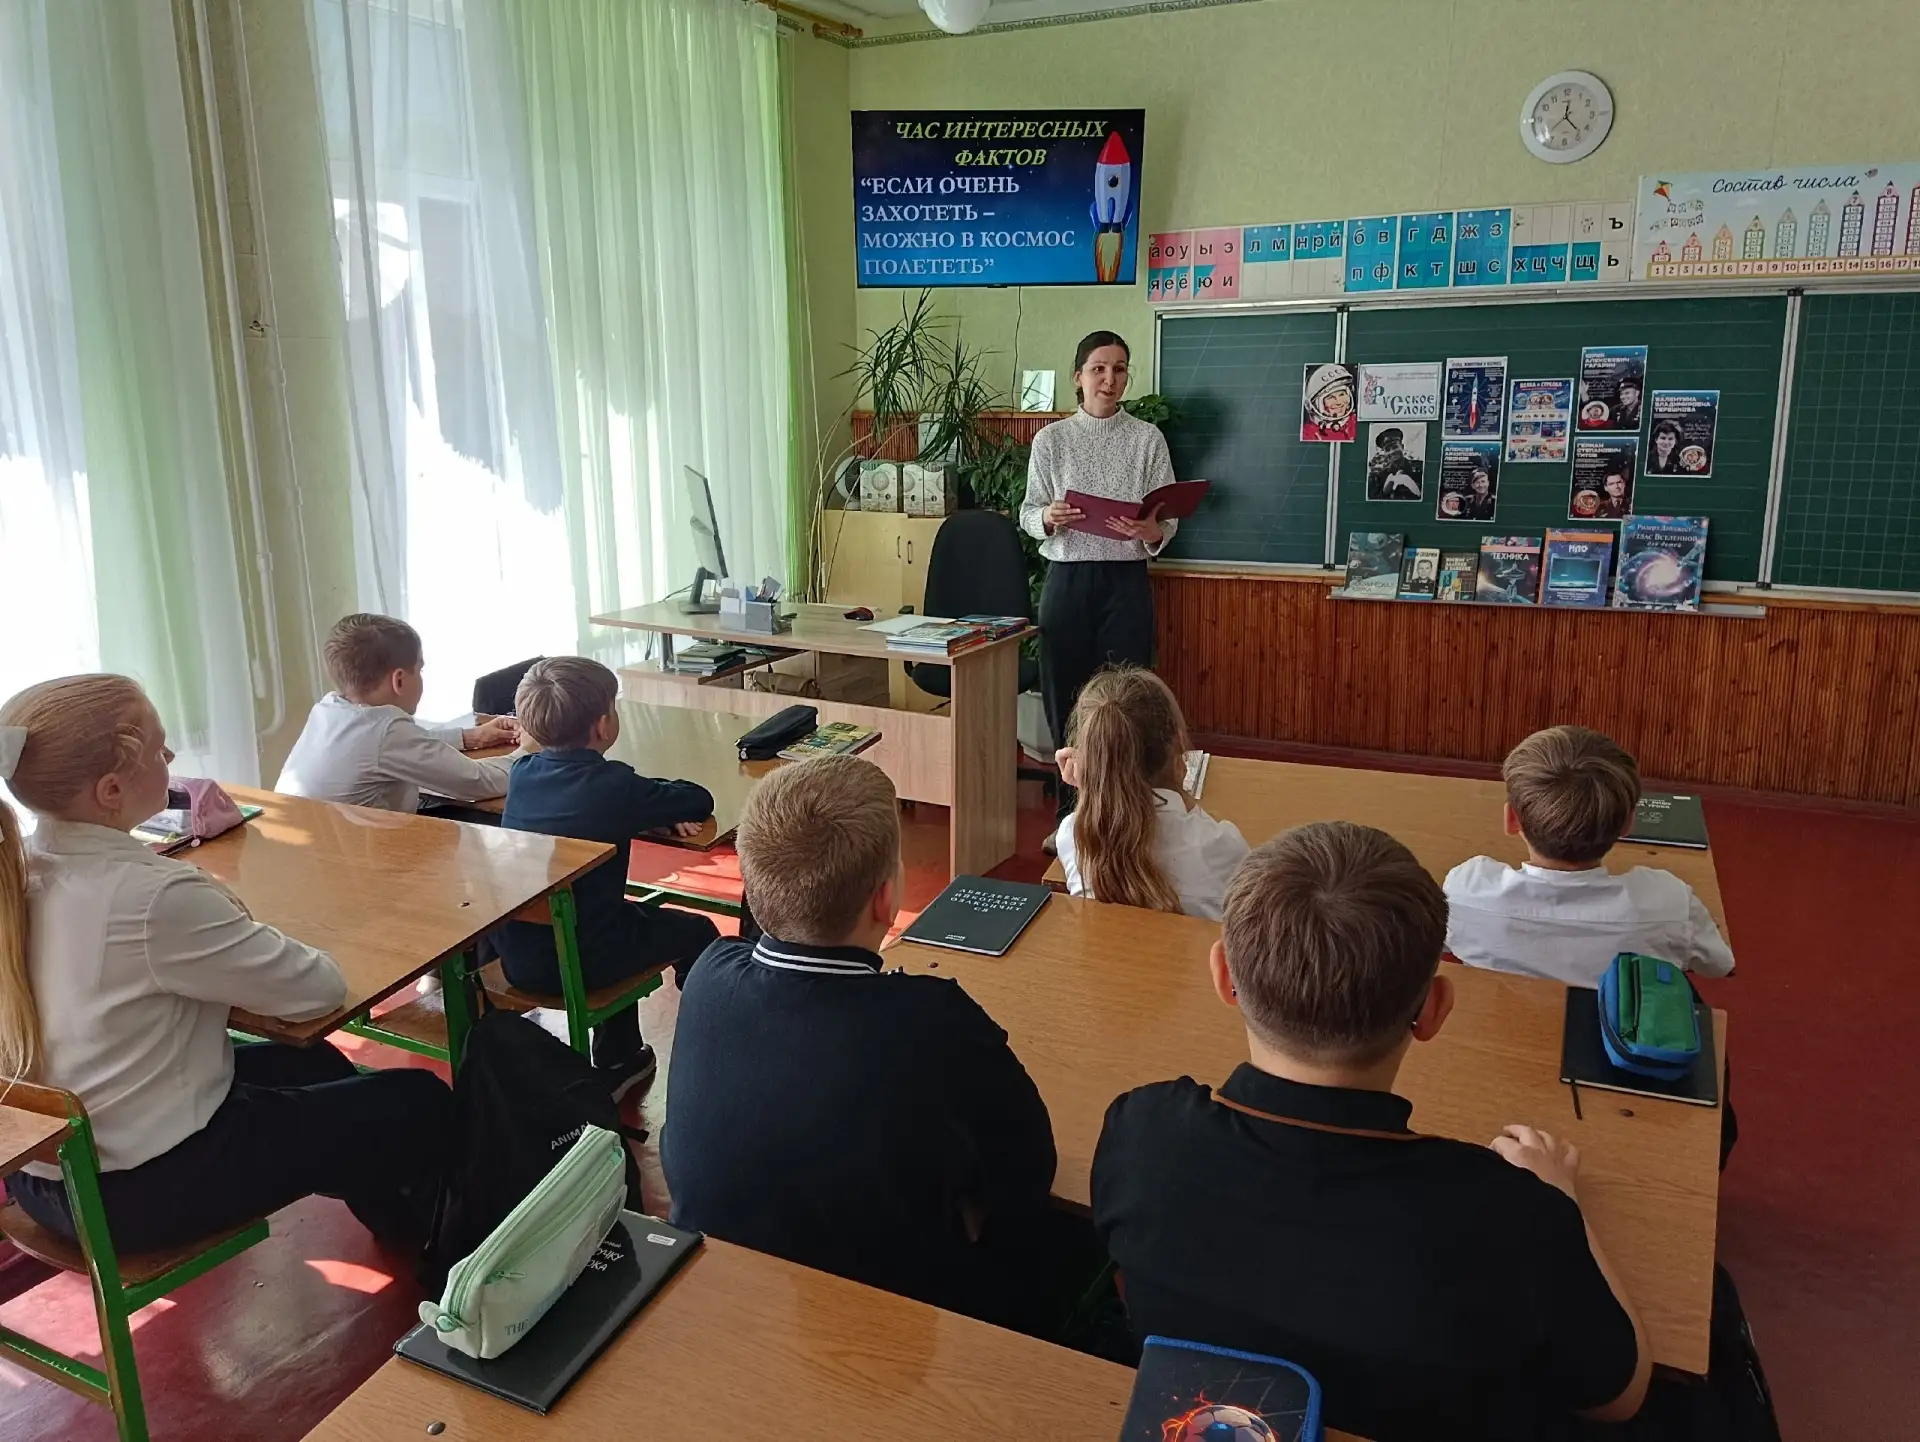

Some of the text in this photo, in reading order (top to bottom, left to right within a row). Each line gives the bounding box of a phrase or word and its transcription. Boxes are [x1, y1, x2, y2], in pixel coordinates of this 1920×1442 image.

[896, 121, 1109, 140] ЧАС ИНТЕРЕСНЫХ
[955, 149, 1047, 166] ФАКТОВ
[939, 176, 1020, 194] ОЧЕНЬ
[1712, 175, 1860, 193] Состав числа
[862, 205, 979, 222] ЗАХОТЕТЬ
[863, 230, 1075, 249] МОЖНО В КОСМОС
[1151, 217, 1623, 259] а о у ы э л м н р й б в г д ж з ъ
[1150, 254, 1619, 289] я е ё ю и п ф к т ш с х ц ч щ ь
[1669, 266, 1674, 274] 2
[1712, 265, 1718, 273] 5
[1742, 264, 1748, 272] 7
[1772, 263, 1778, 271] 9
[1785, 263, 1796, 271] 10
[1802, 263, 1811, 271] 11
[1816, 262, 1827, 270] 12
[1832, 261, 1843, 270] 13
[1848, 261, 1859, 269] 14
[1880, 260, 1891, 268] 16
[1493, 552, 1530, 563] ТЕХНИКА
